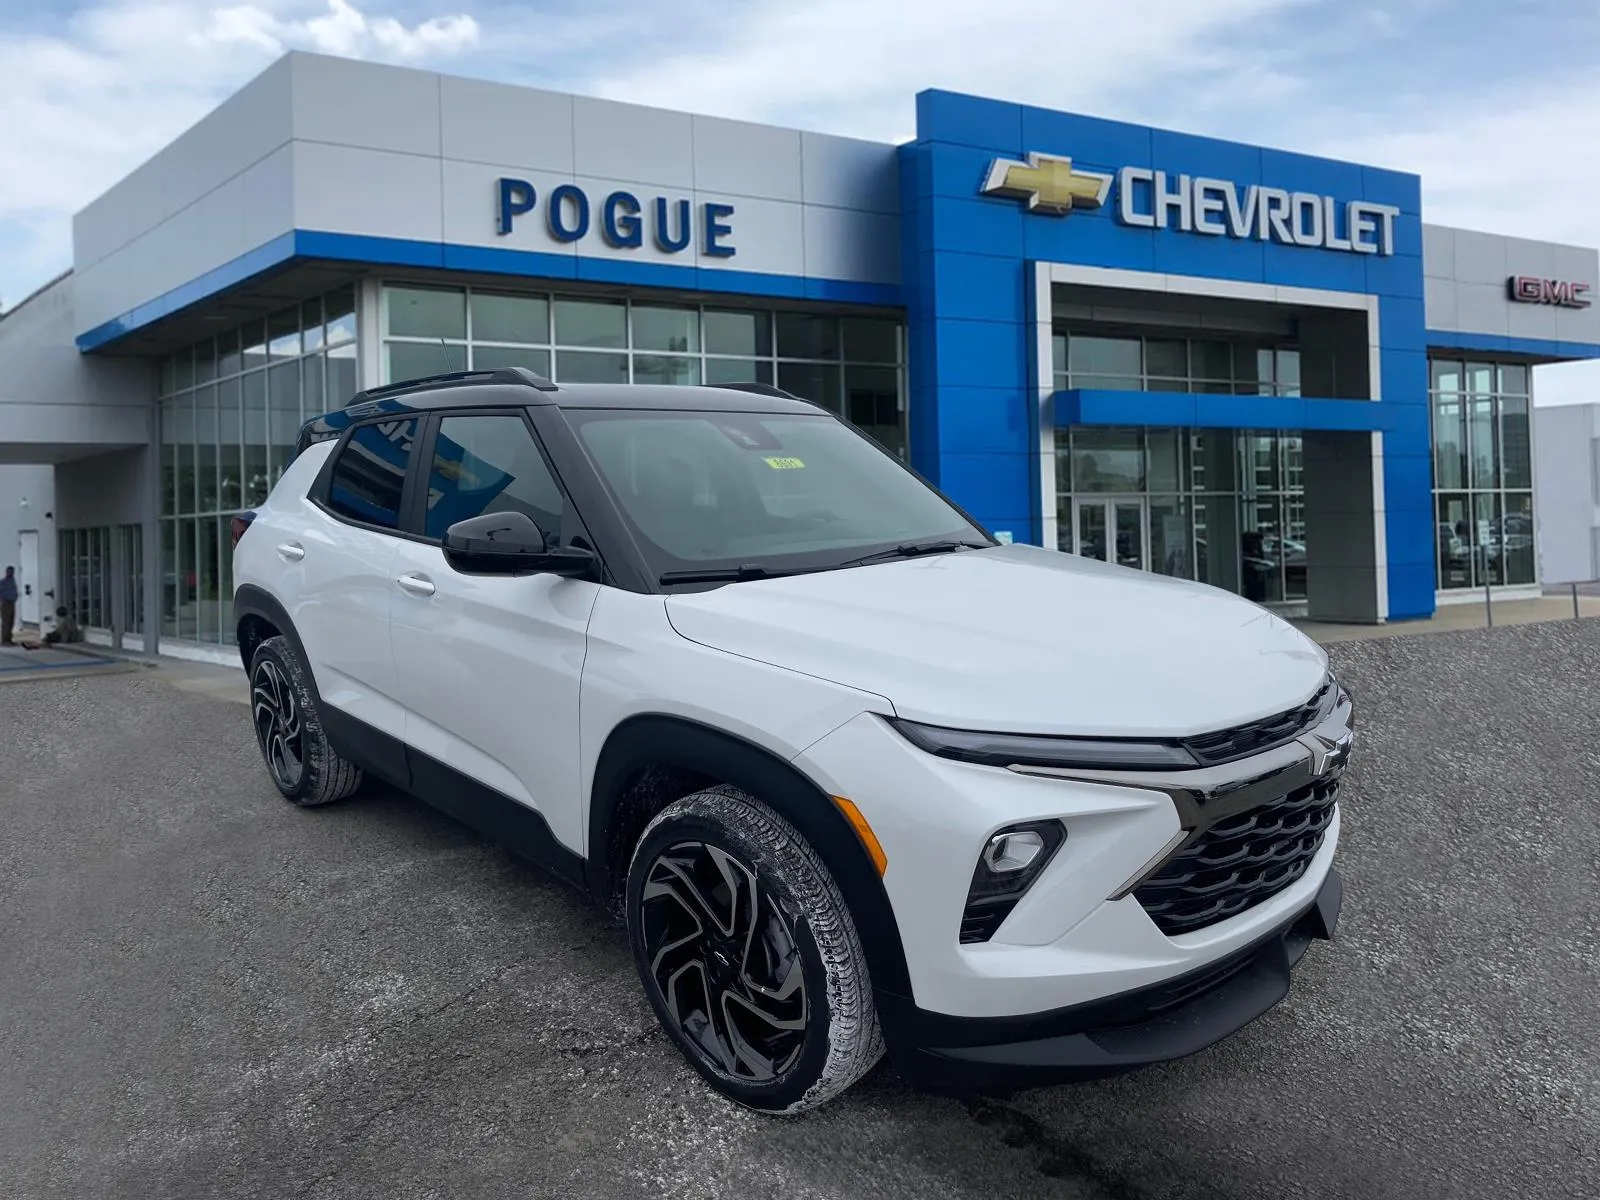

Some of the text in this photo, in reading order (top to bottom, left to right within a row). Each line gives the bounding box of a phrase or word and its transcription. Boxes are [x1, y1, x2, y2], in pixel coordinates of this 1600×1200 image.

[497, 177, 737, 257] POGUE
[1118, 166, 1400, 256] CHEVROLET
[1509, 275, 1592, 309] GMC
